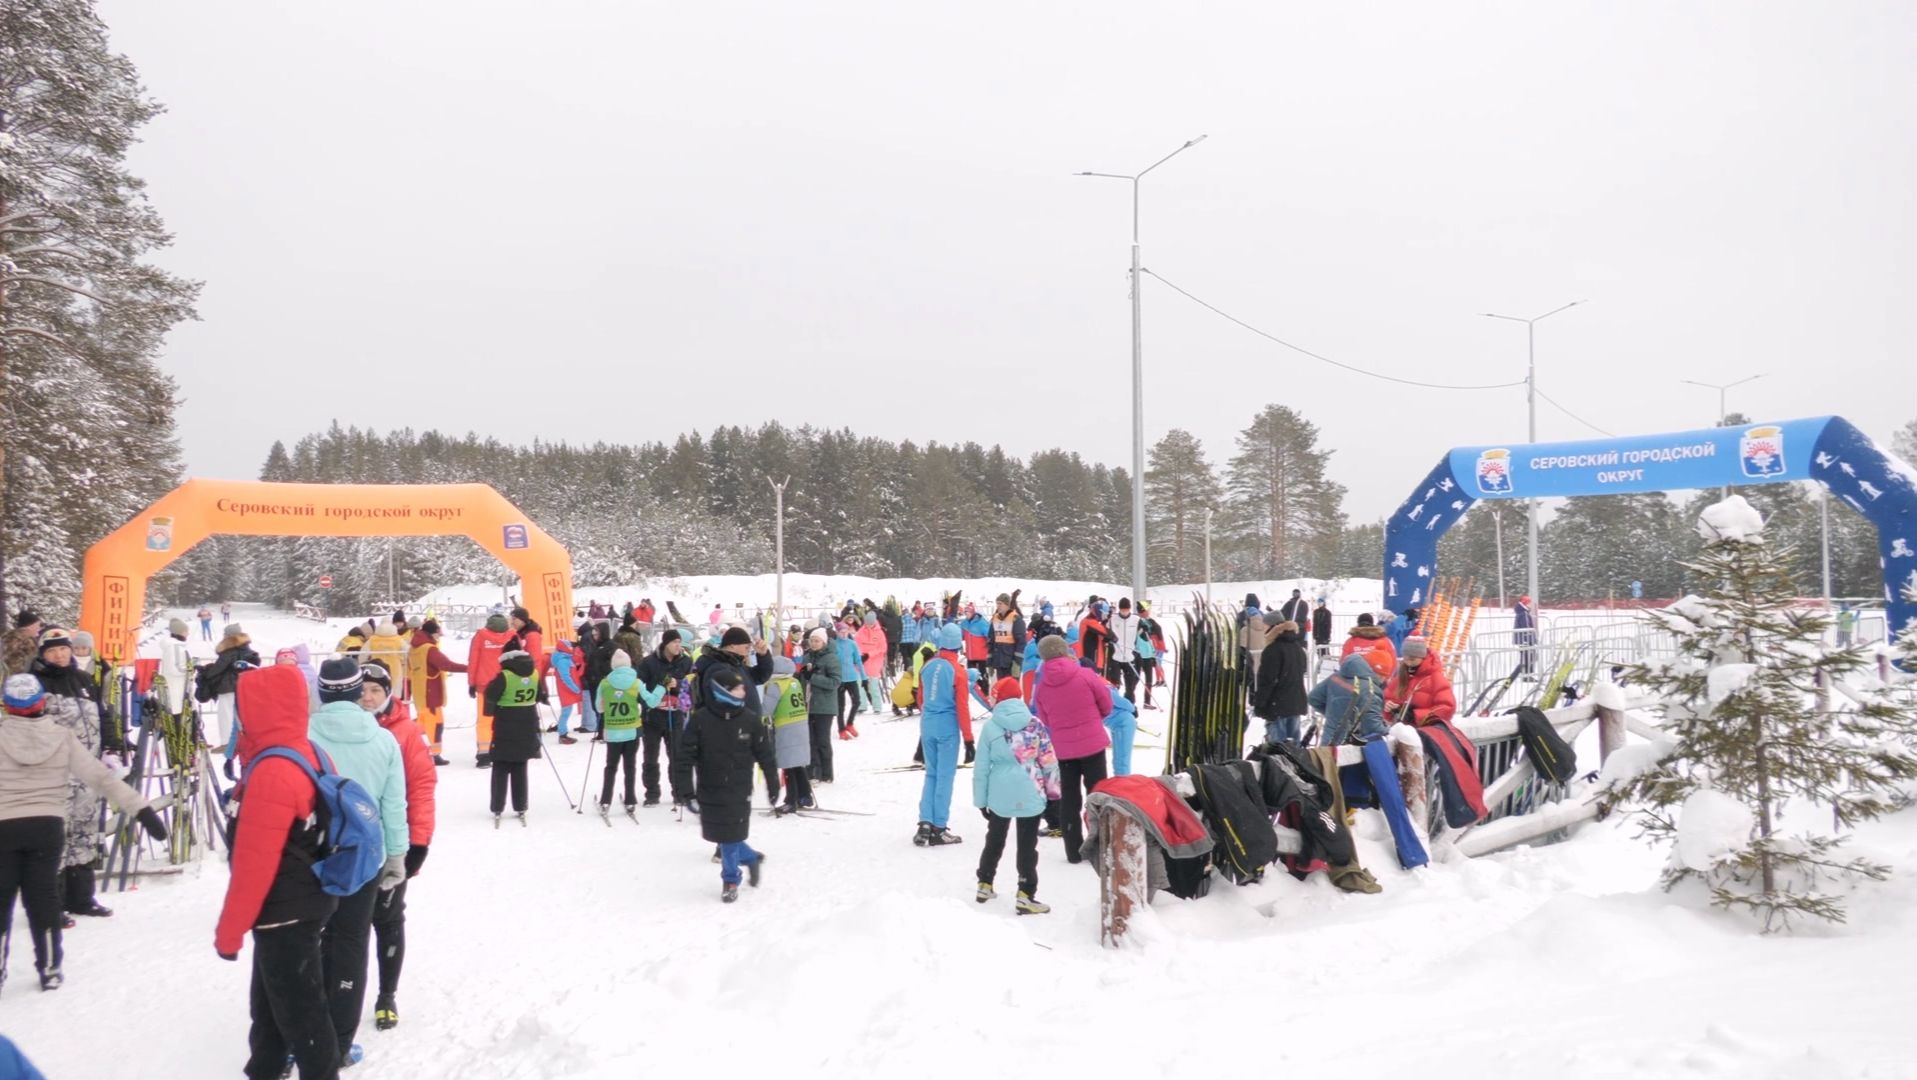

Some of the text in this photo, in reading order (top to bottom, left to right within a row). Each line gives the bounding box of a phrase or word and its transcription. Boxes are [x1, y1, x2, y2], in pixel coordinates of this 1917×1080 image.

[1530, 442, 1716, 470] СЕРОВСКИЙ ГОРОДСКОЙ
[1597, 469, 1644, 484] ОКРУГ
[216, 498, 465, 521] Серовский городской округ
[609, 702, 630, 717] 70
